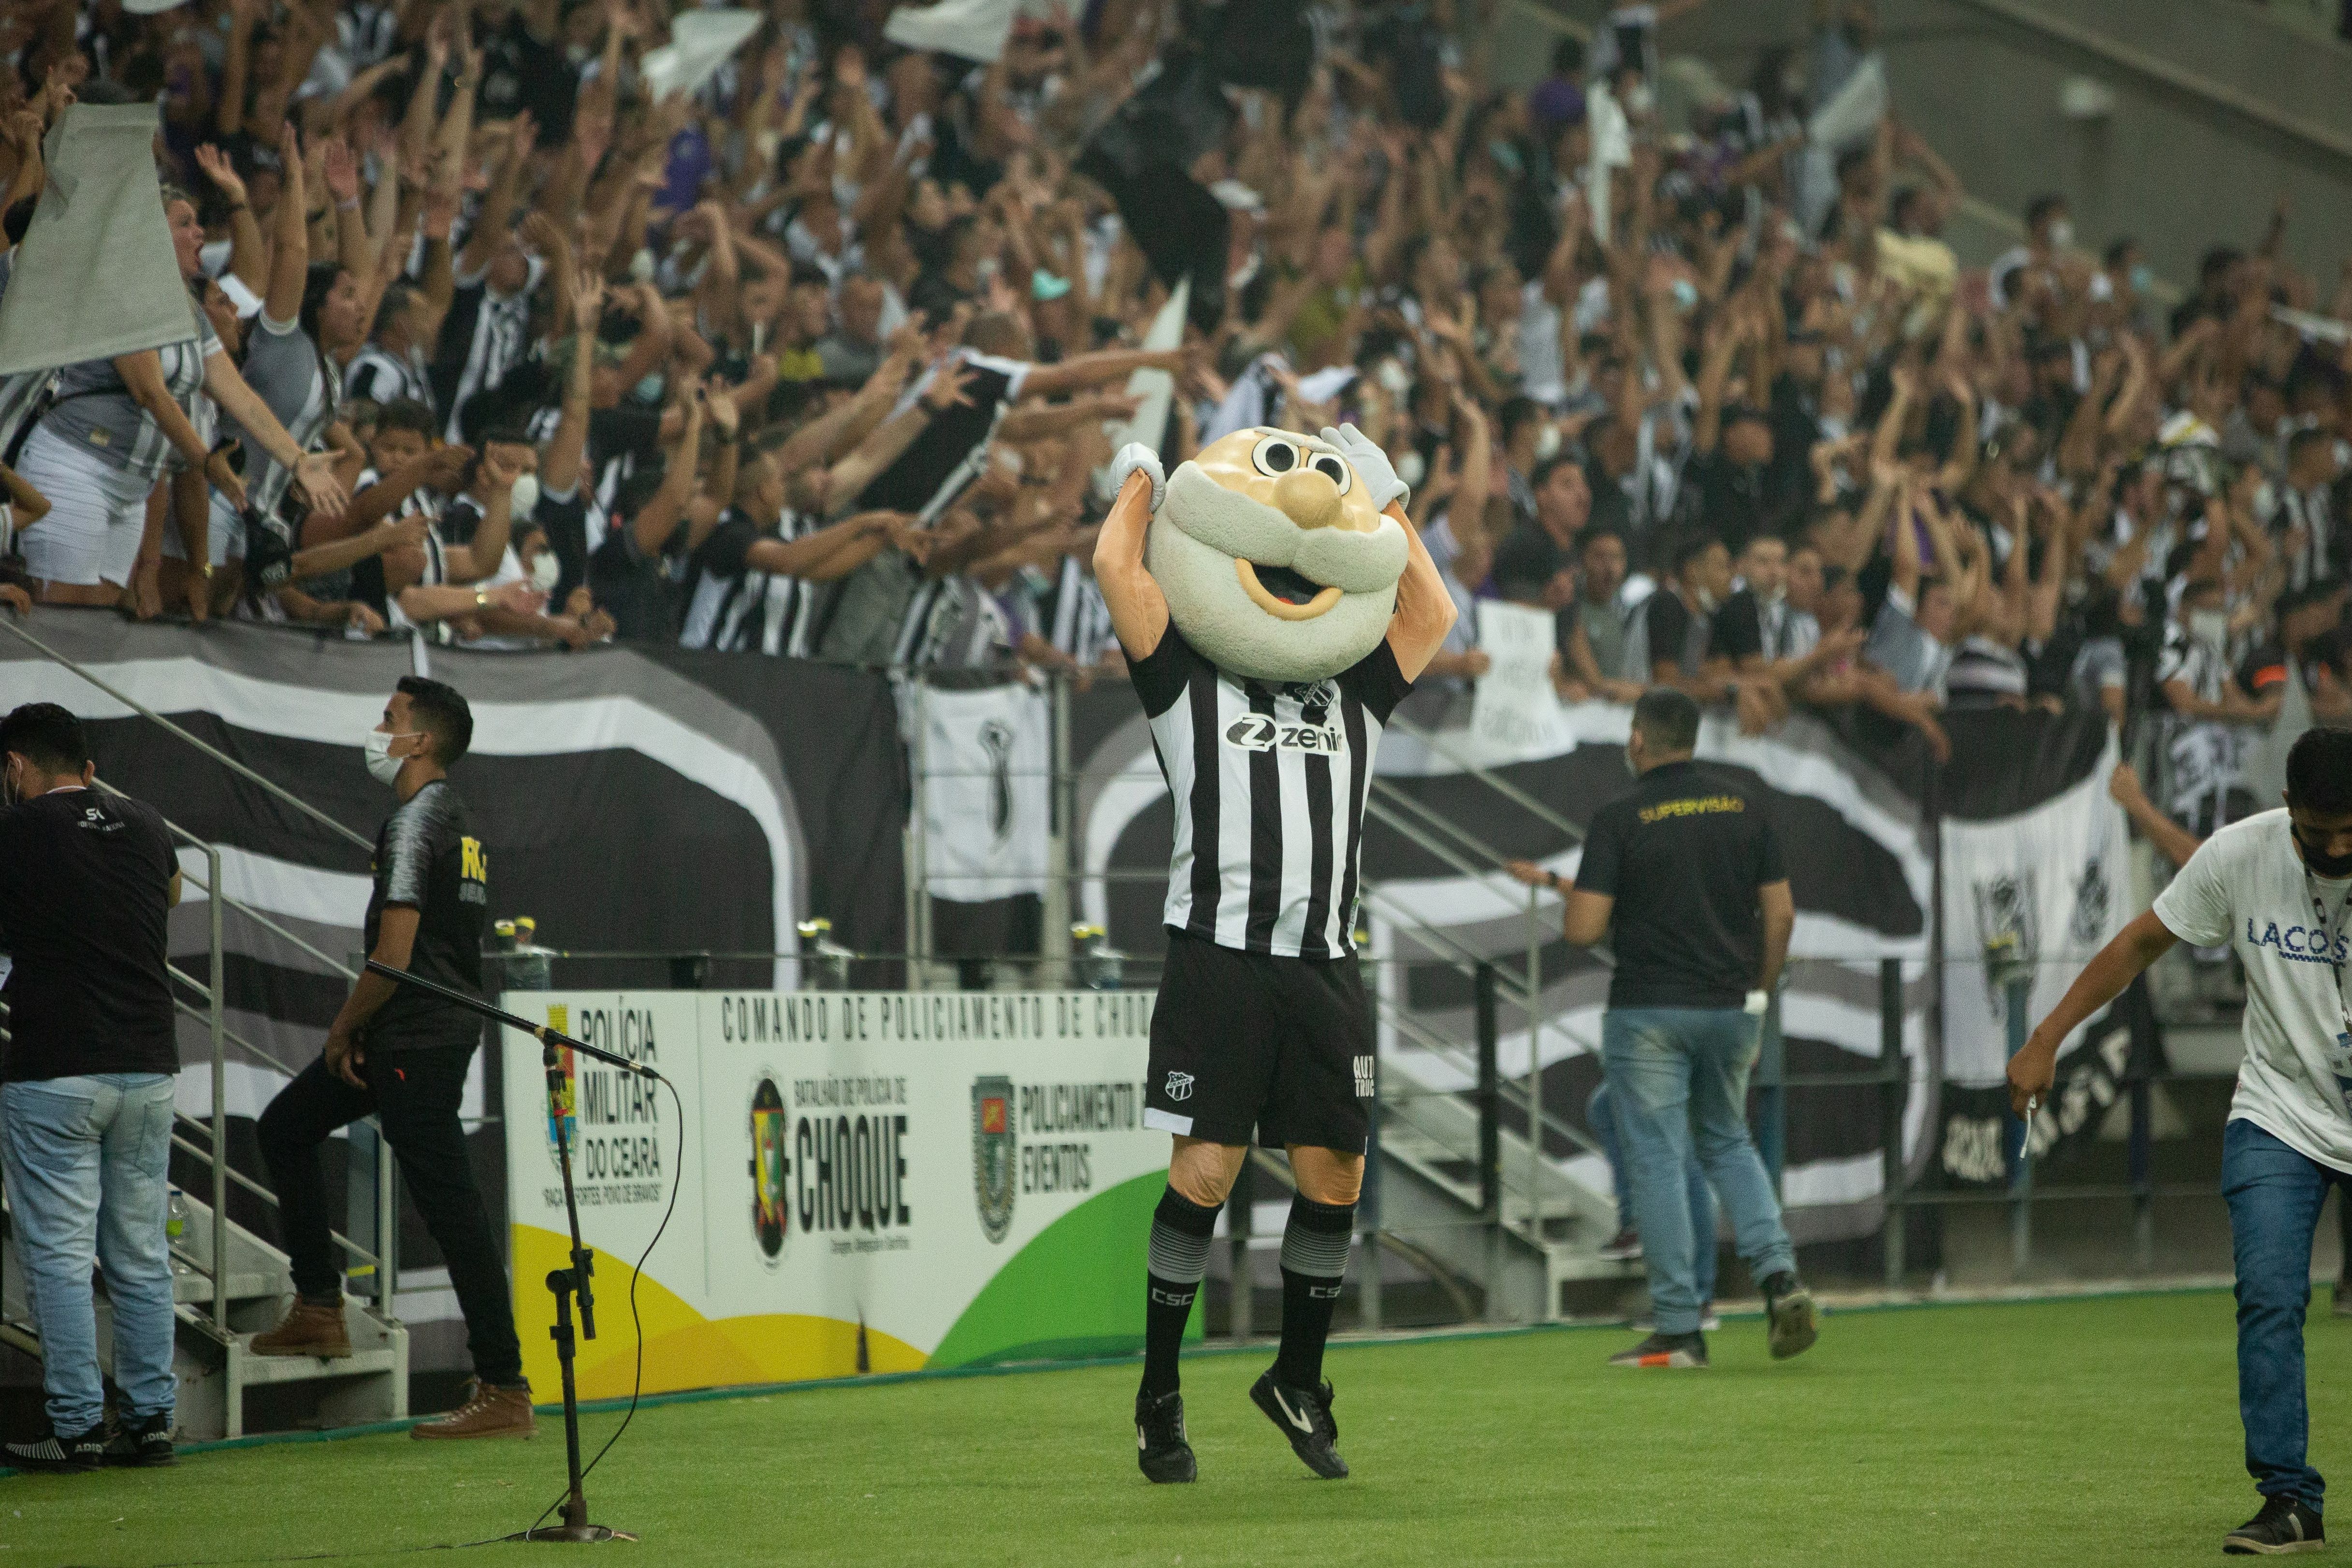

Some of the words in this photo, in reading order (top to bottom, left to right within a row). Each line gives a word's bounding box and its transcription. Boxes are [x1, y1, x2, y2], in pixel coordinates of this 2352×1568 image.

[581, 996, 658, 1063] POLÍCIA
[722, 996, 830, 1043] COMANDO
[842, 996, 868, 1042] DE
[881, 996, 1045, 1042] POLICIAMENTO
[1056, 996, 1083, 1039] DE
[1353, 1055, 1375, 1079] AUT
[583, 1069, 659, 1125] MILITAR
[1021, 1083, 1135, 1135] POLICIAMENTO
[585, 1138, 606, 1179] DO
[611, 1126, 663, 1178] CEARÁ
[796, 1114, 911, 1235] CHOQUE
[1022, 1142, 1091, 1194] EVENTOS
[1152, 1288, 1194, 1306] CSC
